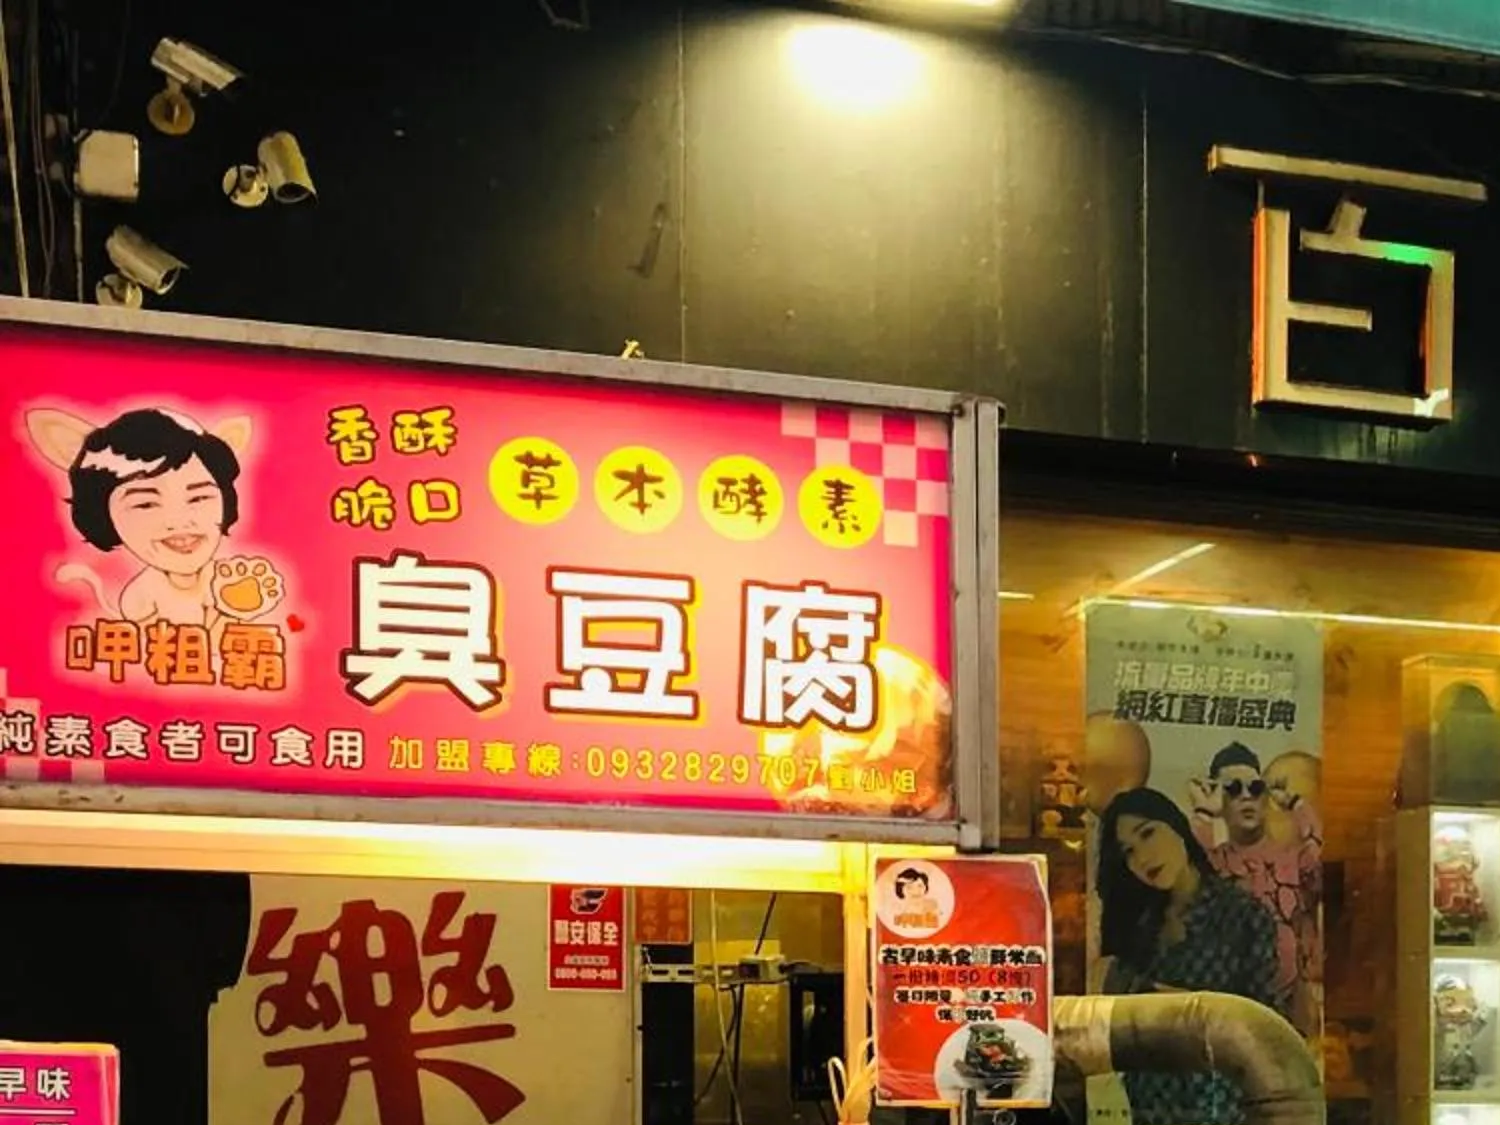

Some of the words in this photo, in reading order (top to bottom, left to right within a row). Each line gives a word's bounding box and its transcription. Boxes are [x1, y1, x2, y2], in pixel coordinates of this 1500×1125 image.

[327, 405, 457, 465] 香酥
[331, 478, 463, 531] 脆口
[514, 449, 862, 536] 草本酵素
[65, 617, 287, 692] 呷粗霸
[343, 551, 880, 734] 臭豆腐
[0, 712, 365, 770] 純素食者可食用
[0, 1067, 72, 1100] 早味
